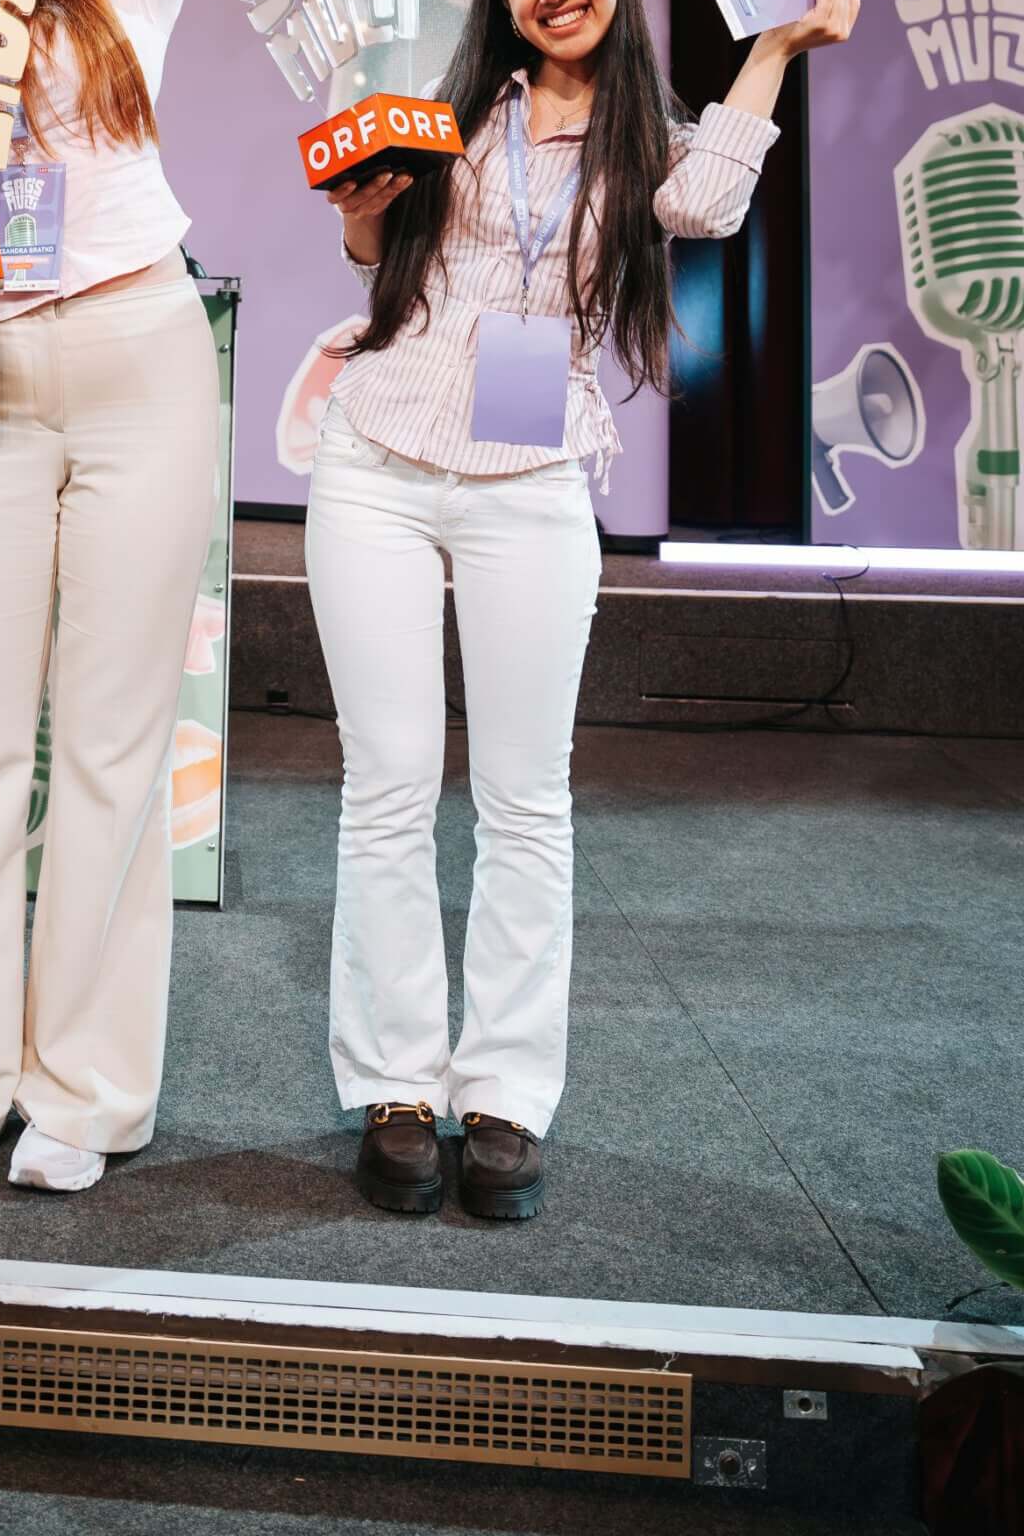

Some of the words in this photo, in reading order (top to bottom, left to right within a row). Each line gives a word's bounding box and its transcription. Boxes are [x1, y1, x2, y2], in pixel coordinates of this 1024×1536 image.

[906, 15, 1024, 91] MUL
[308, 110, 377, 170] ORF
[388, 107, 453, 141] ORF
[1, 177, 46, 195] SAG'S
[5, 193, 40, 212] MULTI
